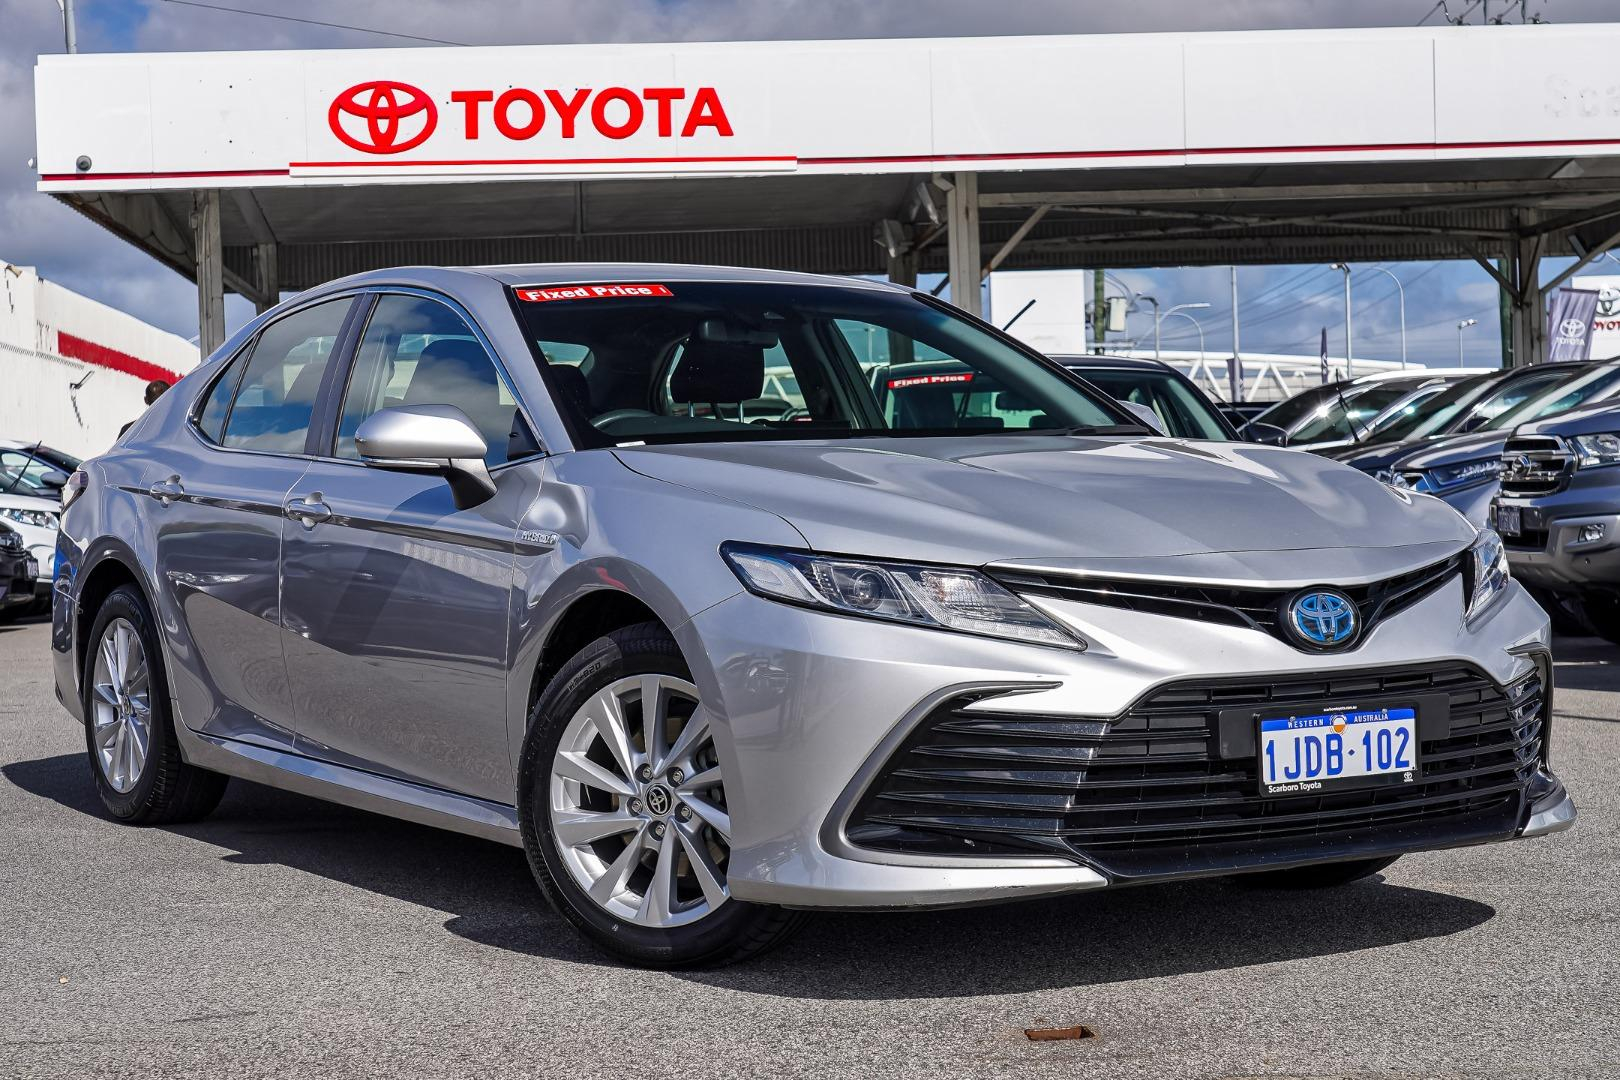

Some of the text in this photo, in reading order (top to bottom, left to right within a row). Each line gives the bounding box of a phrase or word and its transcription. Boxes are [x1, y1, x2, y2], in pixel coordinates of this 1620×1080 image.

[451, 86, 733, 140] TOYOTA
[525, 286, 653, 301] Fixed Price
[893, 375, 966, 388] Fixed Price
[1287, 712, 1389, 729] WESTERN AUSTRALIA
[1268, 781, 1322, 794] Scarboro Toyota
